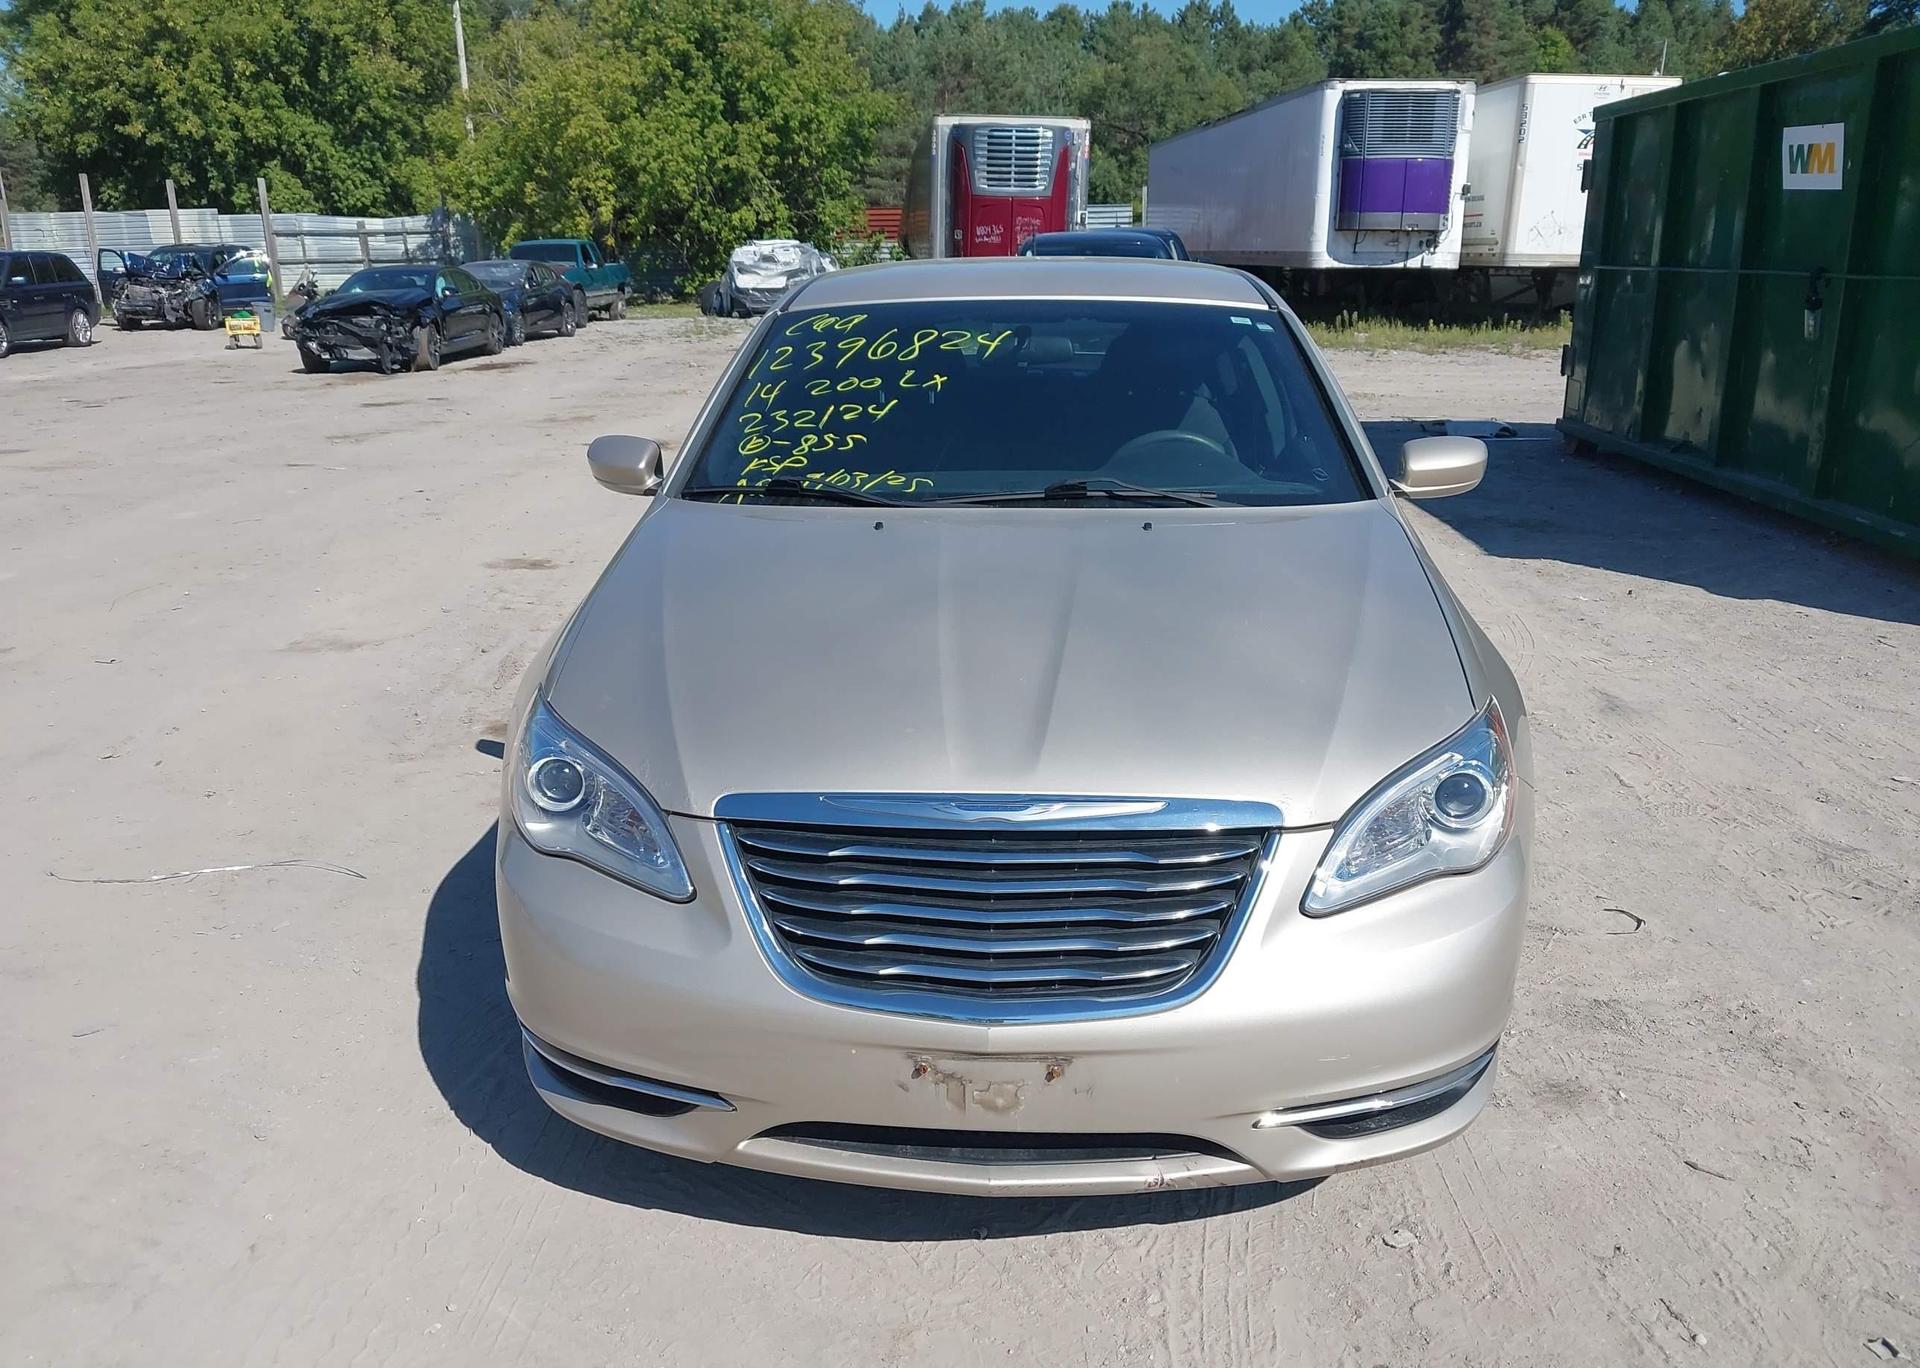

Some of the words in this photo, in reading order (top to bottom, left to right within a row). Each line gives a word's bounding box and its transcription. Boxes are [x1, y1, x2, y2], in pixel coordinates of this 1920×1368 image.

[1517, 102, 1529, 144] 53202
[1788, 143, 1836, 175] WM
[748, 329, 1013, 380] 12396824
[744, 380, 788, 411] 14
[805, 376, 882, 396] 200
[738, 399, 899, 434] 232124
